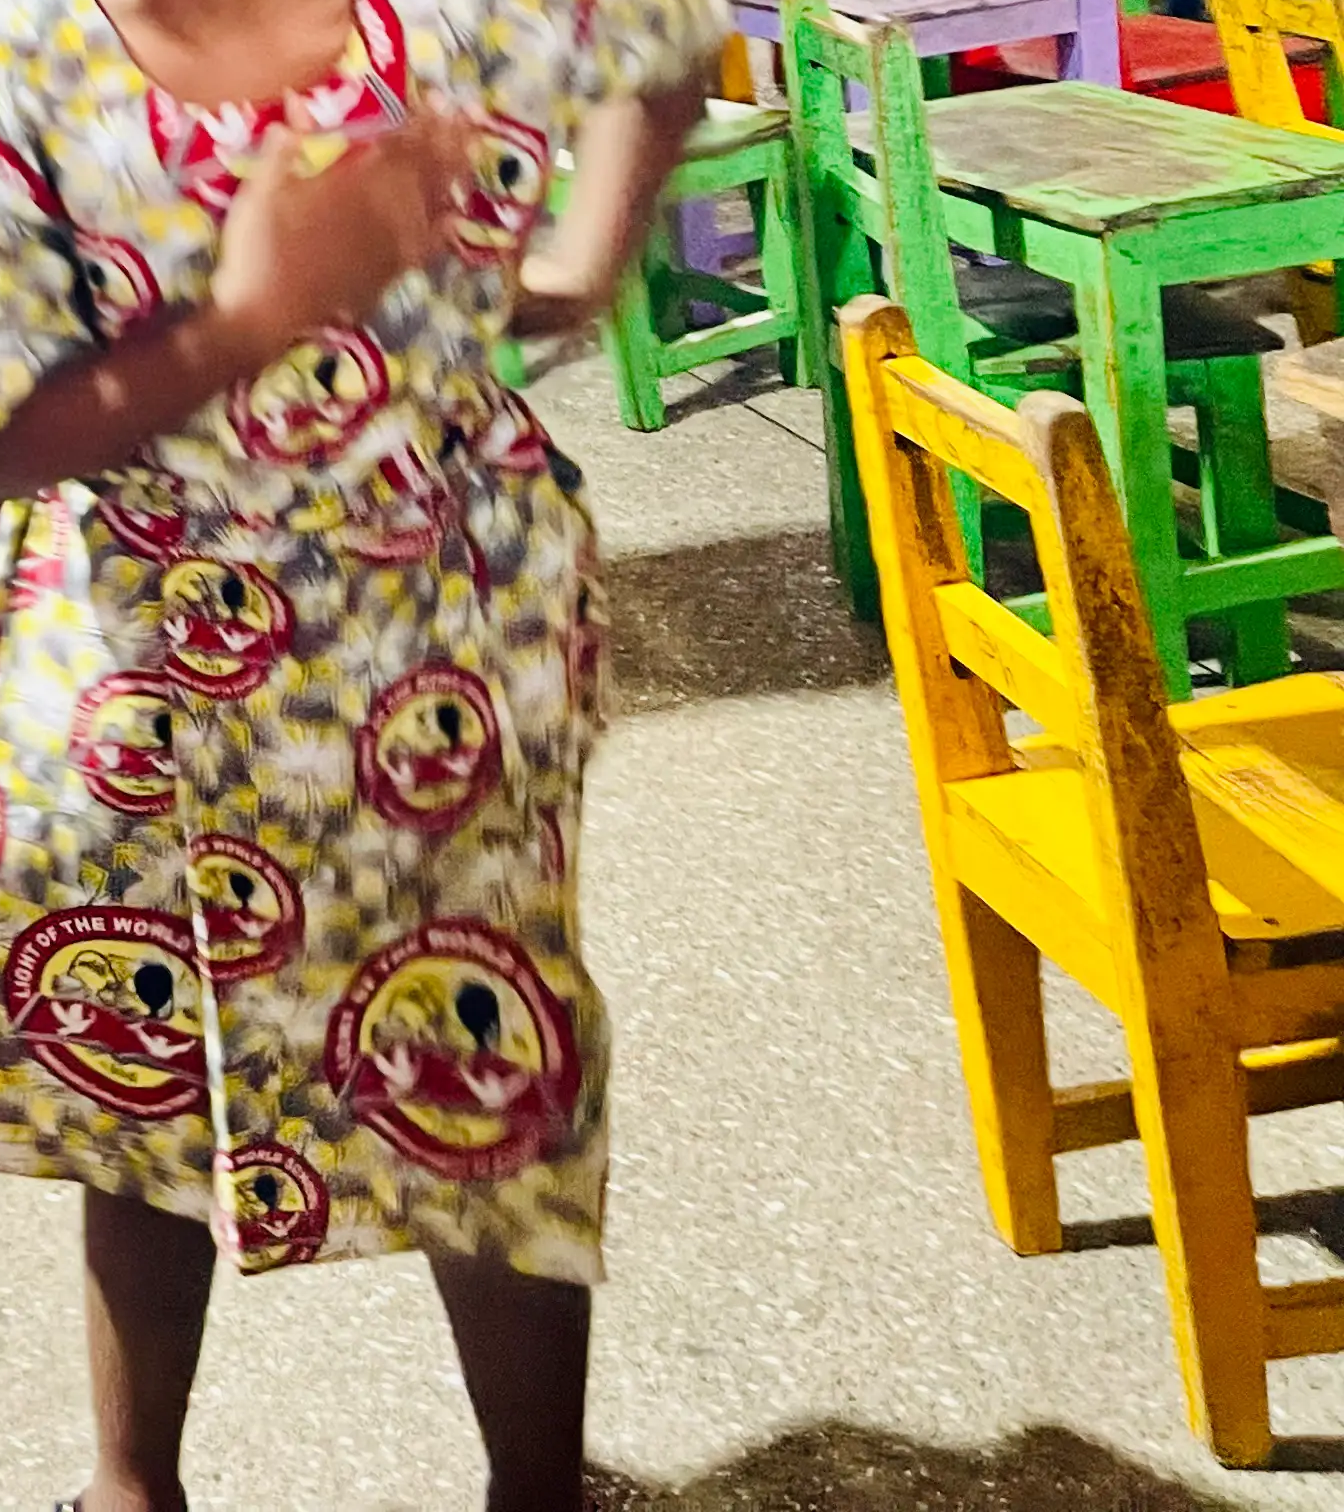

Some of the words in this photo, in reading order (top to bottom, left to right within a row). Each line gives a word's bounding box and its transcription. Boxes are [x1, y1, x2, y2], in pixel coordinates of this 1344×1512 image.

[13, 941, 41, 999] LIGHT
[35, 925, 58, 948] OF
[60, 916, 106, 935] THE
[113, 917, 191, 952] WORLD
